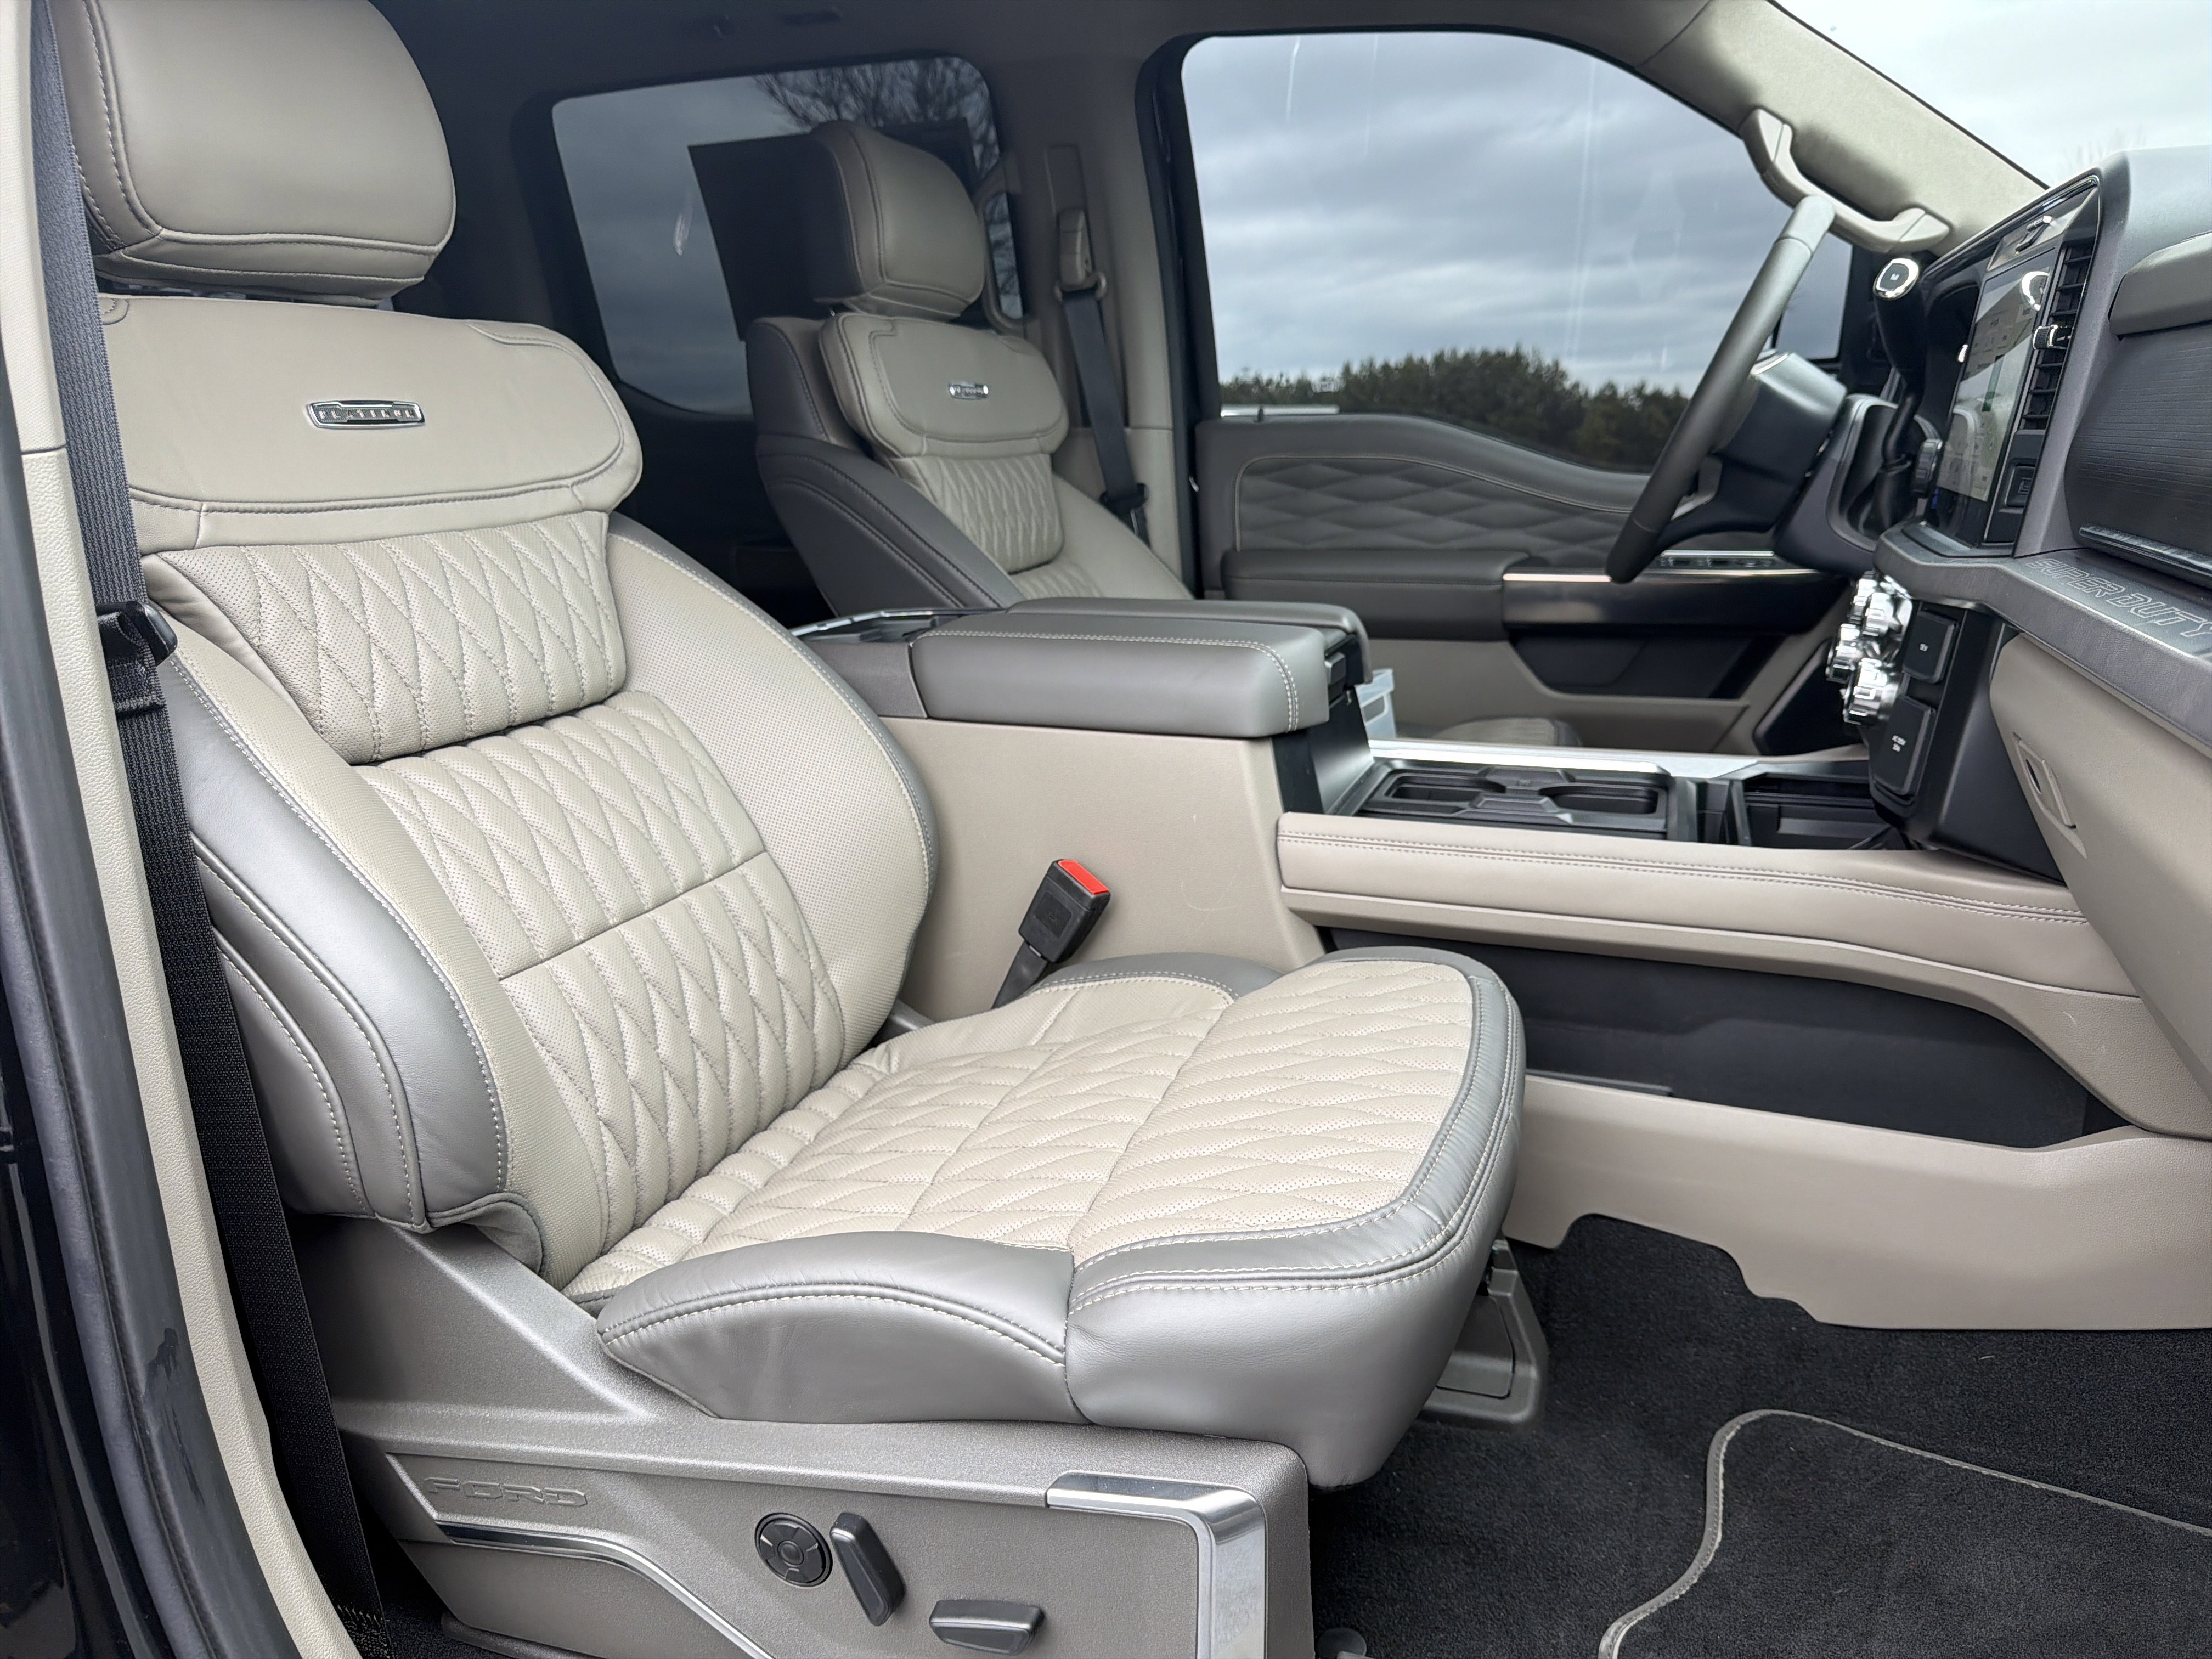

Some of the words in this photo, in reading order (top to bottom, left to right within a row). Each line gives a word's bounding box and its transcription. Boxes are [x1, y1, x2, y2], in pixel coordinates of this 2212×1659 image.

[319, 409, 415, 419] PLATINUM
[2025, 558, 2126, 598] SUPER
[424, 1476, 588, 1507] FORD
